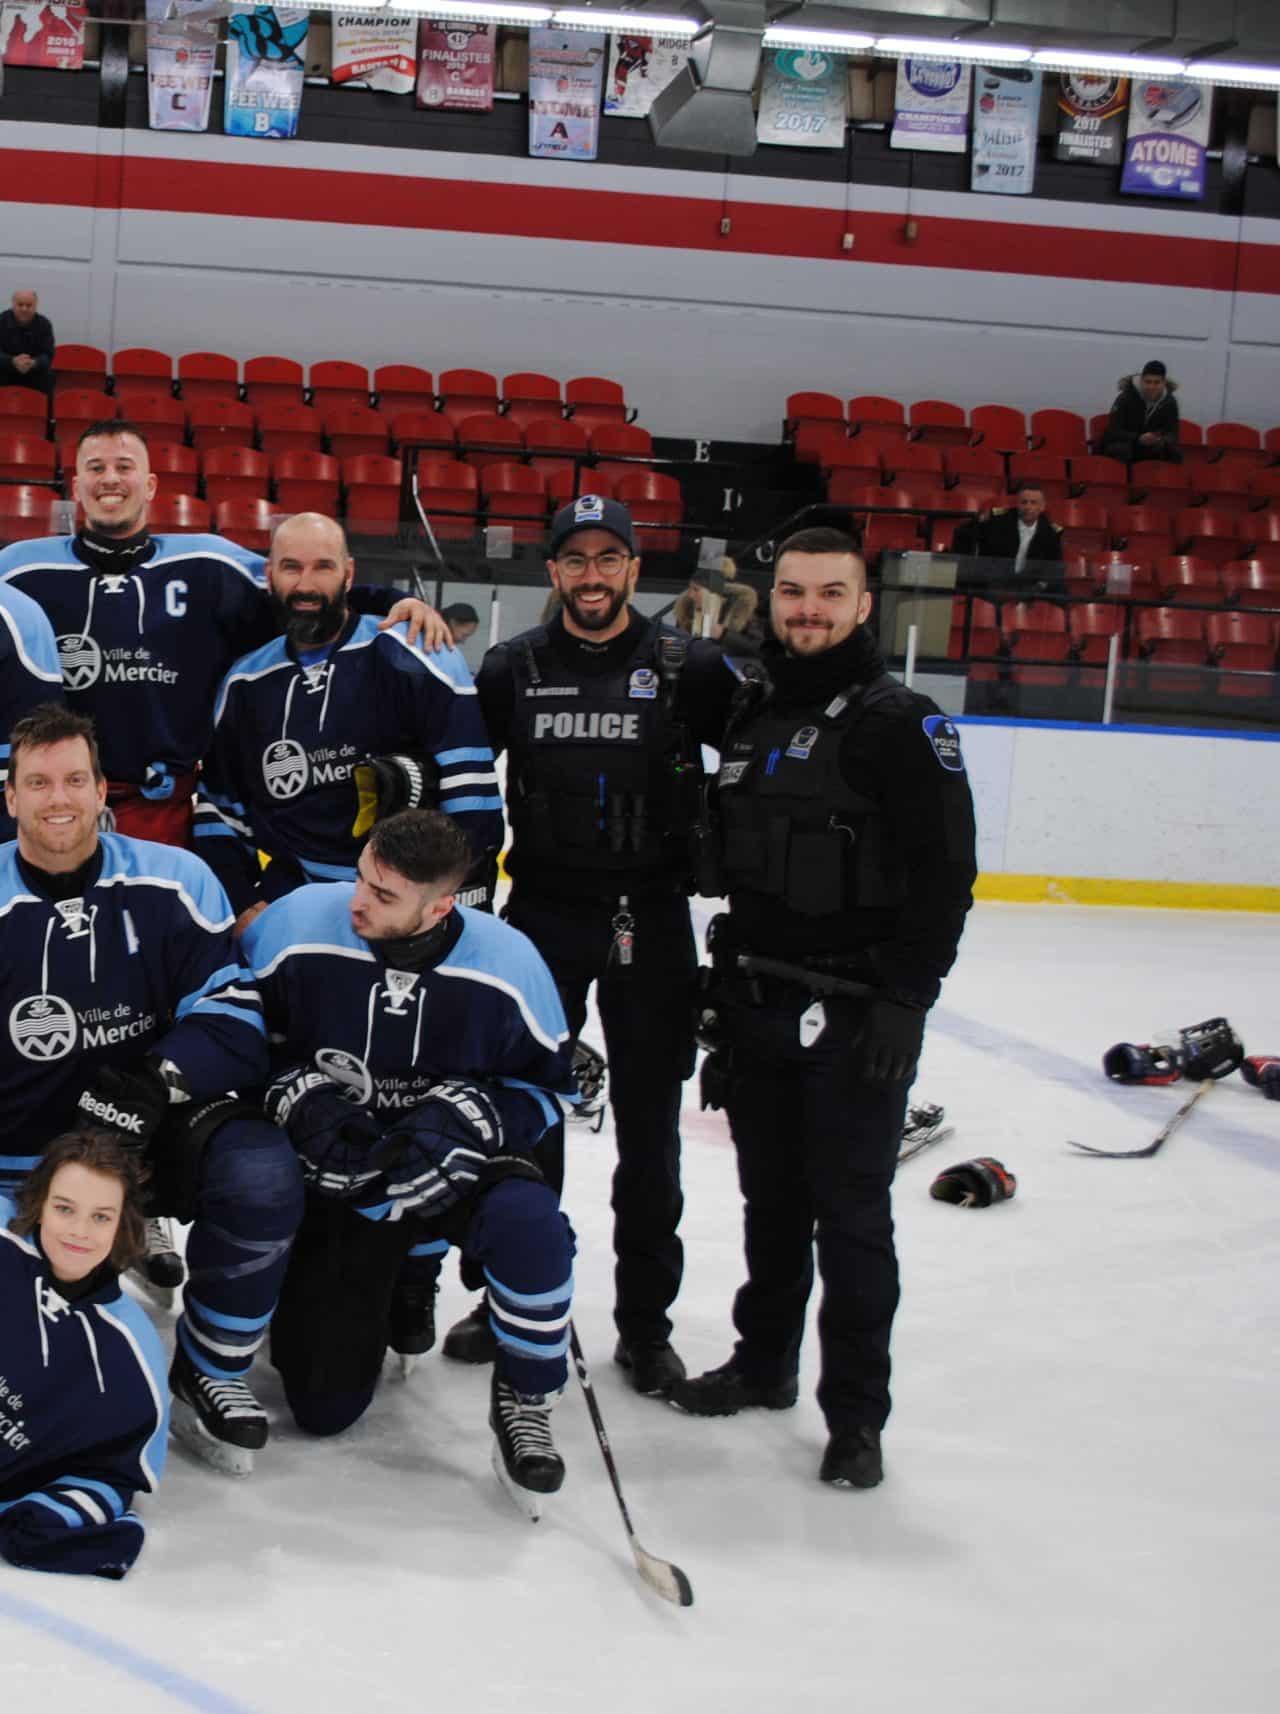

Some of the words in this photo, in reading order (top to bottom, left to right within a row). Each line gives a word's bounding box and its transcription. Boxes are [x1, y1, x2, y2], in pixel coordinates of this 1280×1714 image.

[338, 17, 411, 28] CHAMPION
[422, 49, 491, 64] FINALISTES
[254, 112, 271, 133] B
[549, 121, 569, 139] A
[774, 112, 827, 134] 2017
[1073, 116, 1102, 131] 2017
[1130, 139, 1201, 168] ATOME
[995, 162, 1025, 177] 2017
[694, 440, 712, 464] E
[165, 579, 188, 617] C
[102, 648, 132, 661] Ville
[134, 648, 151, 661] de
[104, 662, 179, 685] Mercier
[534, 711, 640, 740] POLICE
[307, 747, 338, 765] Ville
[339, 743, 357, 758] de
[77, 1007, 111, 1025] Ville
[113, 1003, 132, 1018] de
[374, 1078, 409, 1091] Ville
[7, 1393, 24, 1411] de
